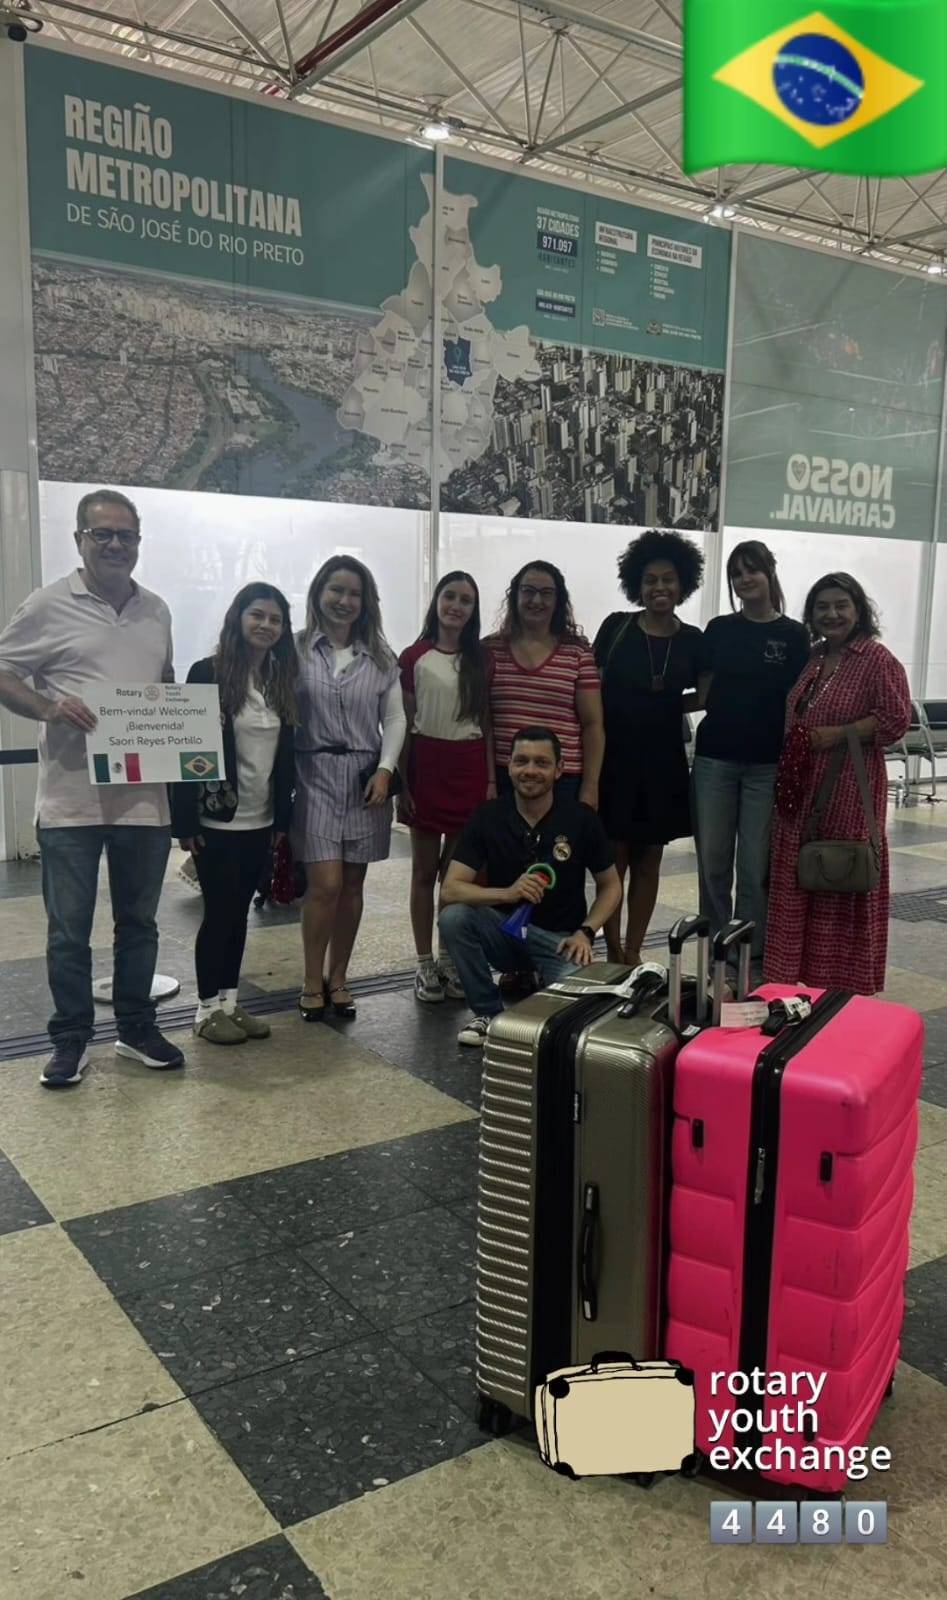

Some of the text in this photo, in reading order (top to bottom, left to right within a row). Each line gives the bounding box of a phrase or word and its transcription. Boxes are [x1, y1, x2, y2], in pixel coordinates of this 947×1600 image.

[64, 94, 172, 159] REGIÃO
[66, 147, 302, 237] METROPOLITANA
[67, 203, 304, 266] DE SÃO JOSÉ DO RIO PRETO
[536, 215, 547, 231] 37
[548, 218, 580, 238] CIDADES
[542, 236, 572, 254] 971.097
[116, 688, 142, 698] Rotary
[99, 706, 207, 716] Bem-vinda! Welcome!
[126, 721, 185, 732] ¡Bienvenida!
[109, 736, 203, 747] Saori Reyes Portillo
